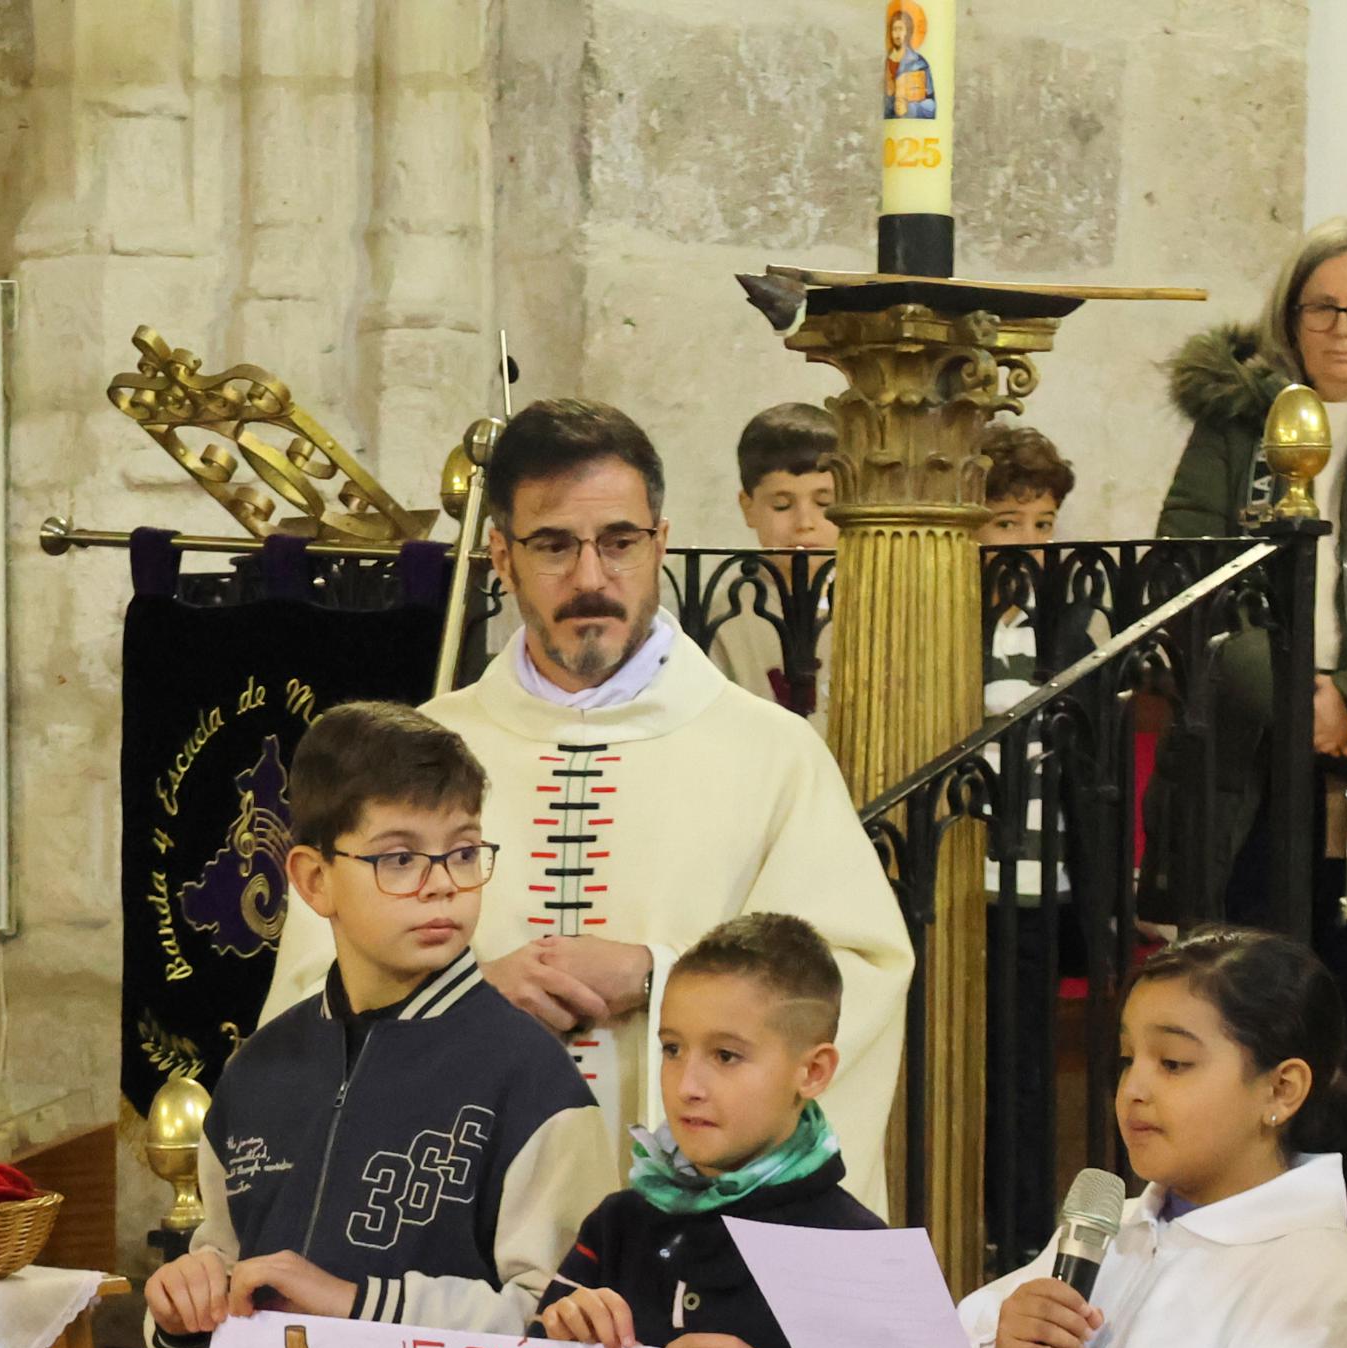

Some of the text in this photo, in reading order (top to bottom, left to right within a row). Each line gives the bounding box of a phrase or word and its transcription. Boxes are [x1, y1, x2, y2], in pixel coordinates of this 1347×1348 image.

[236, 675, 267, 716] de
[155, 706, 226, 817] Escuela
[148, 871, 193, 982] Banda
[346, 1104, 496, 1250] 365
